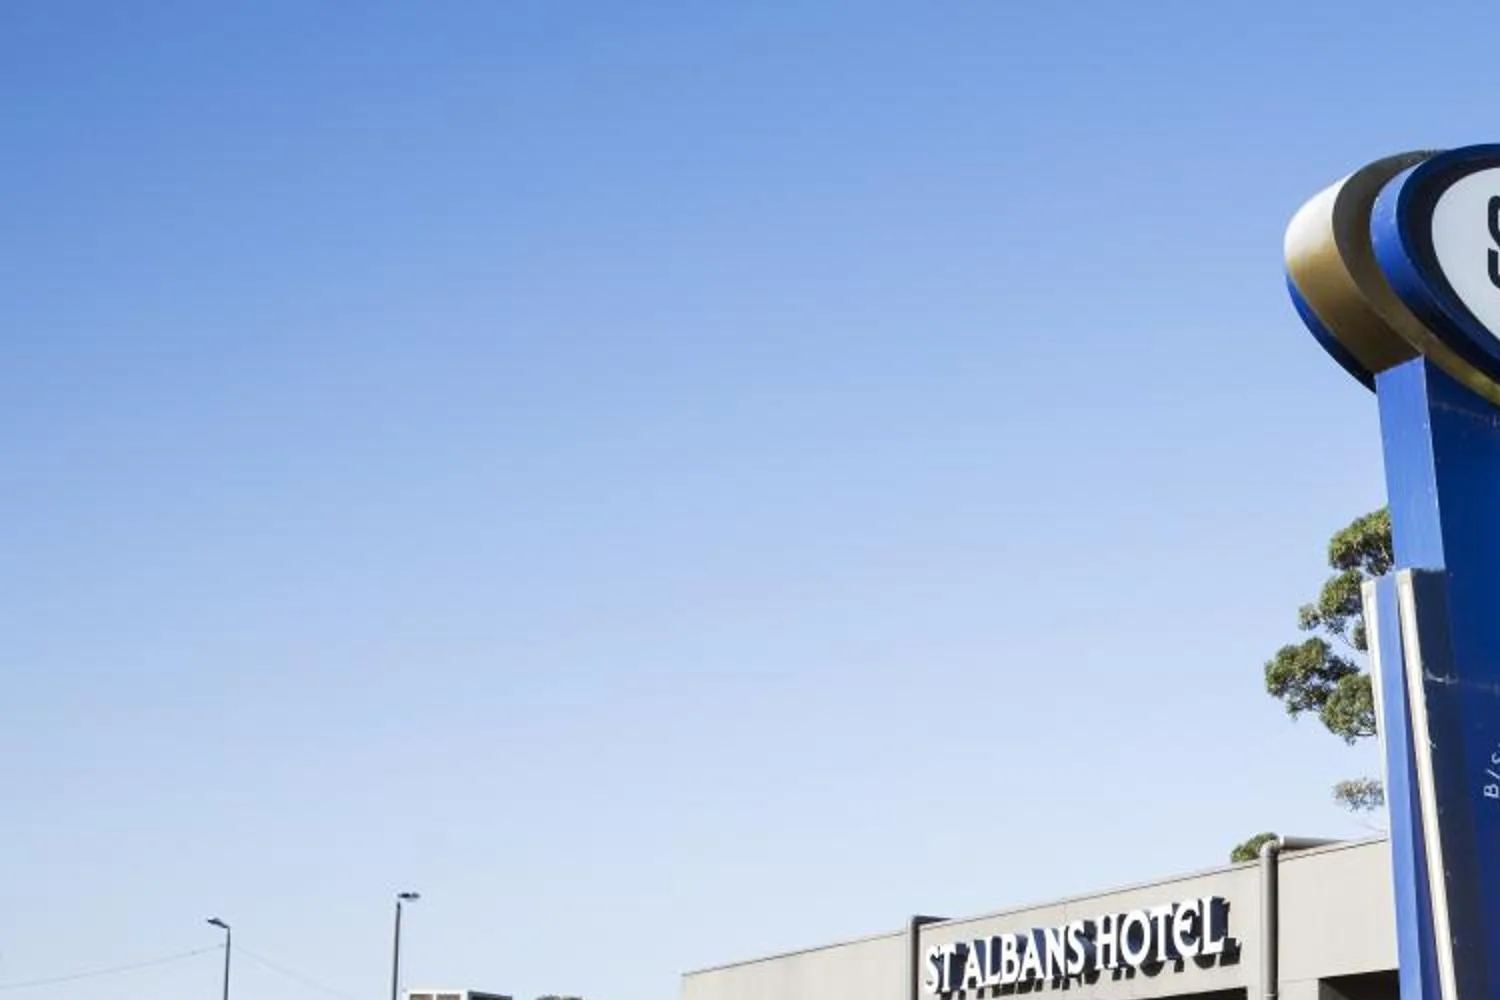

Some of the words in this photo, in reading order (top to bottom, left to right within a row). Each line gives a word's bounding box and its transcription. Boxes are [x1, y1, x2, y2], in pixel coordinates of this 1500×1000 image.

[925, 944, 956, 993] ST
[960, 920, 1085, 989] ALBANS
[1093, 896, 1226, 970] HOTEL
